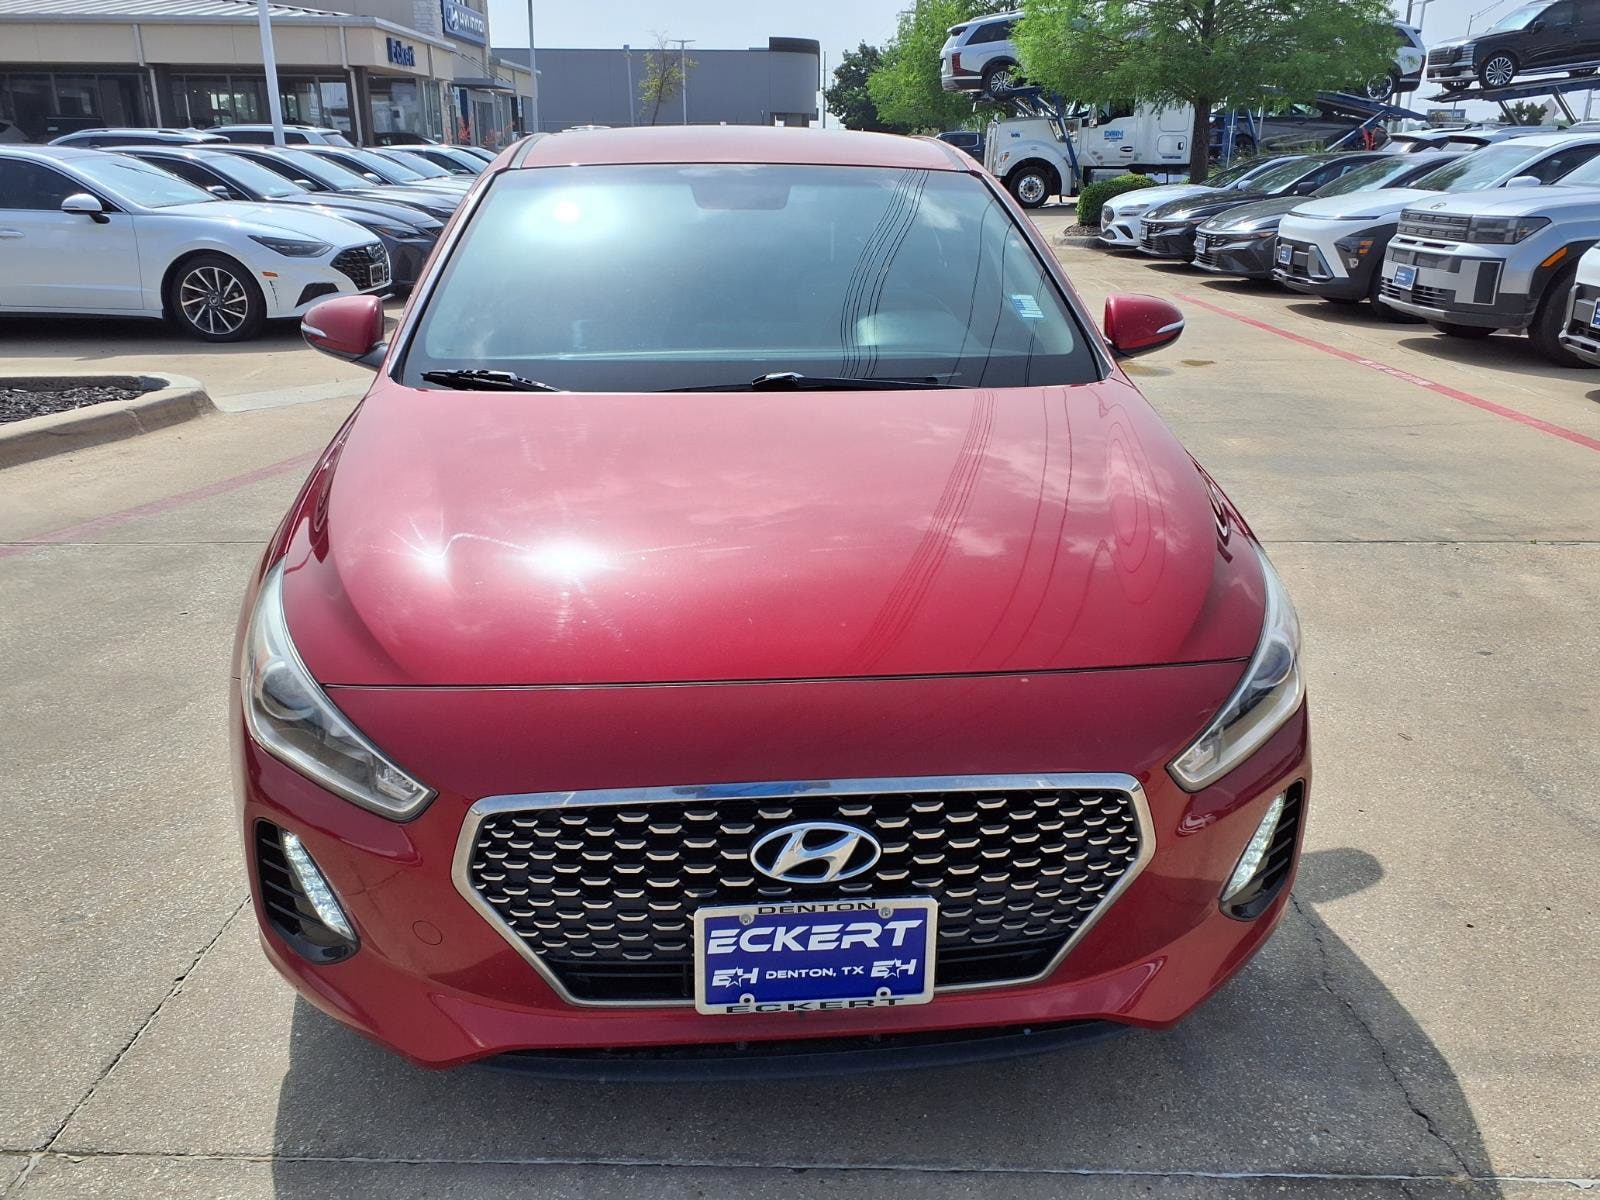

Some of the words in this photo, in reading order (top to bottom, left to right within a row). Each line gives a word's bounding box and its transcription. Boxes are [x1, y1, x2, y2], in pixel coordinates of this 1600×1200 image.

[757, 902, 876, 915] DENTON
[707, 919, 924, 955] ECKERT
[765, 967, 837, 980] DENTON,
[841, 965, 865, 976] TX
[726, 997, 905, 1014] ECKERT
